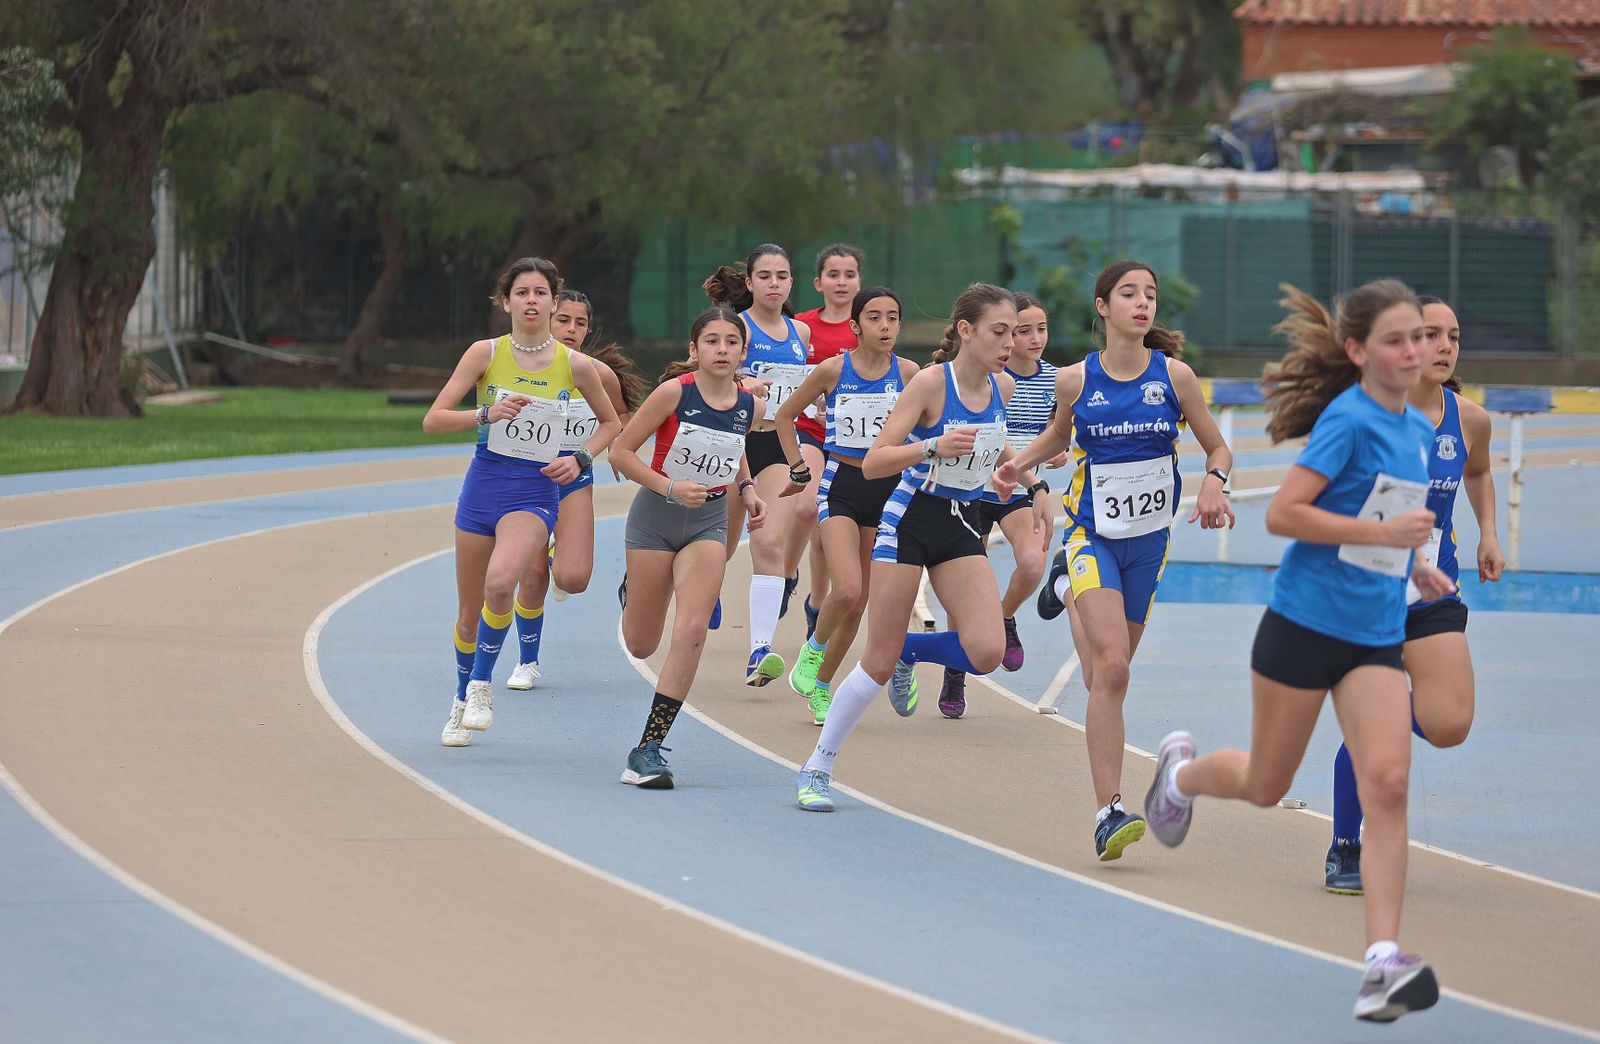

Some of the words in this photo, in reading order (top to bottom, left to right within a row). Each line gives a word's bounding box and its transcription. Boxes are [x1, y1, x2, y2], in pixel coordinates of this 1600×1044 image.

[505, 417, 551, 445] 630
[842, 416, 888, 438] 315
[1087, 418, 1170, 436] Tirabuzón
[674, 447, 734, 478] 3405
[1105, 489, 1166, 519] 3129
